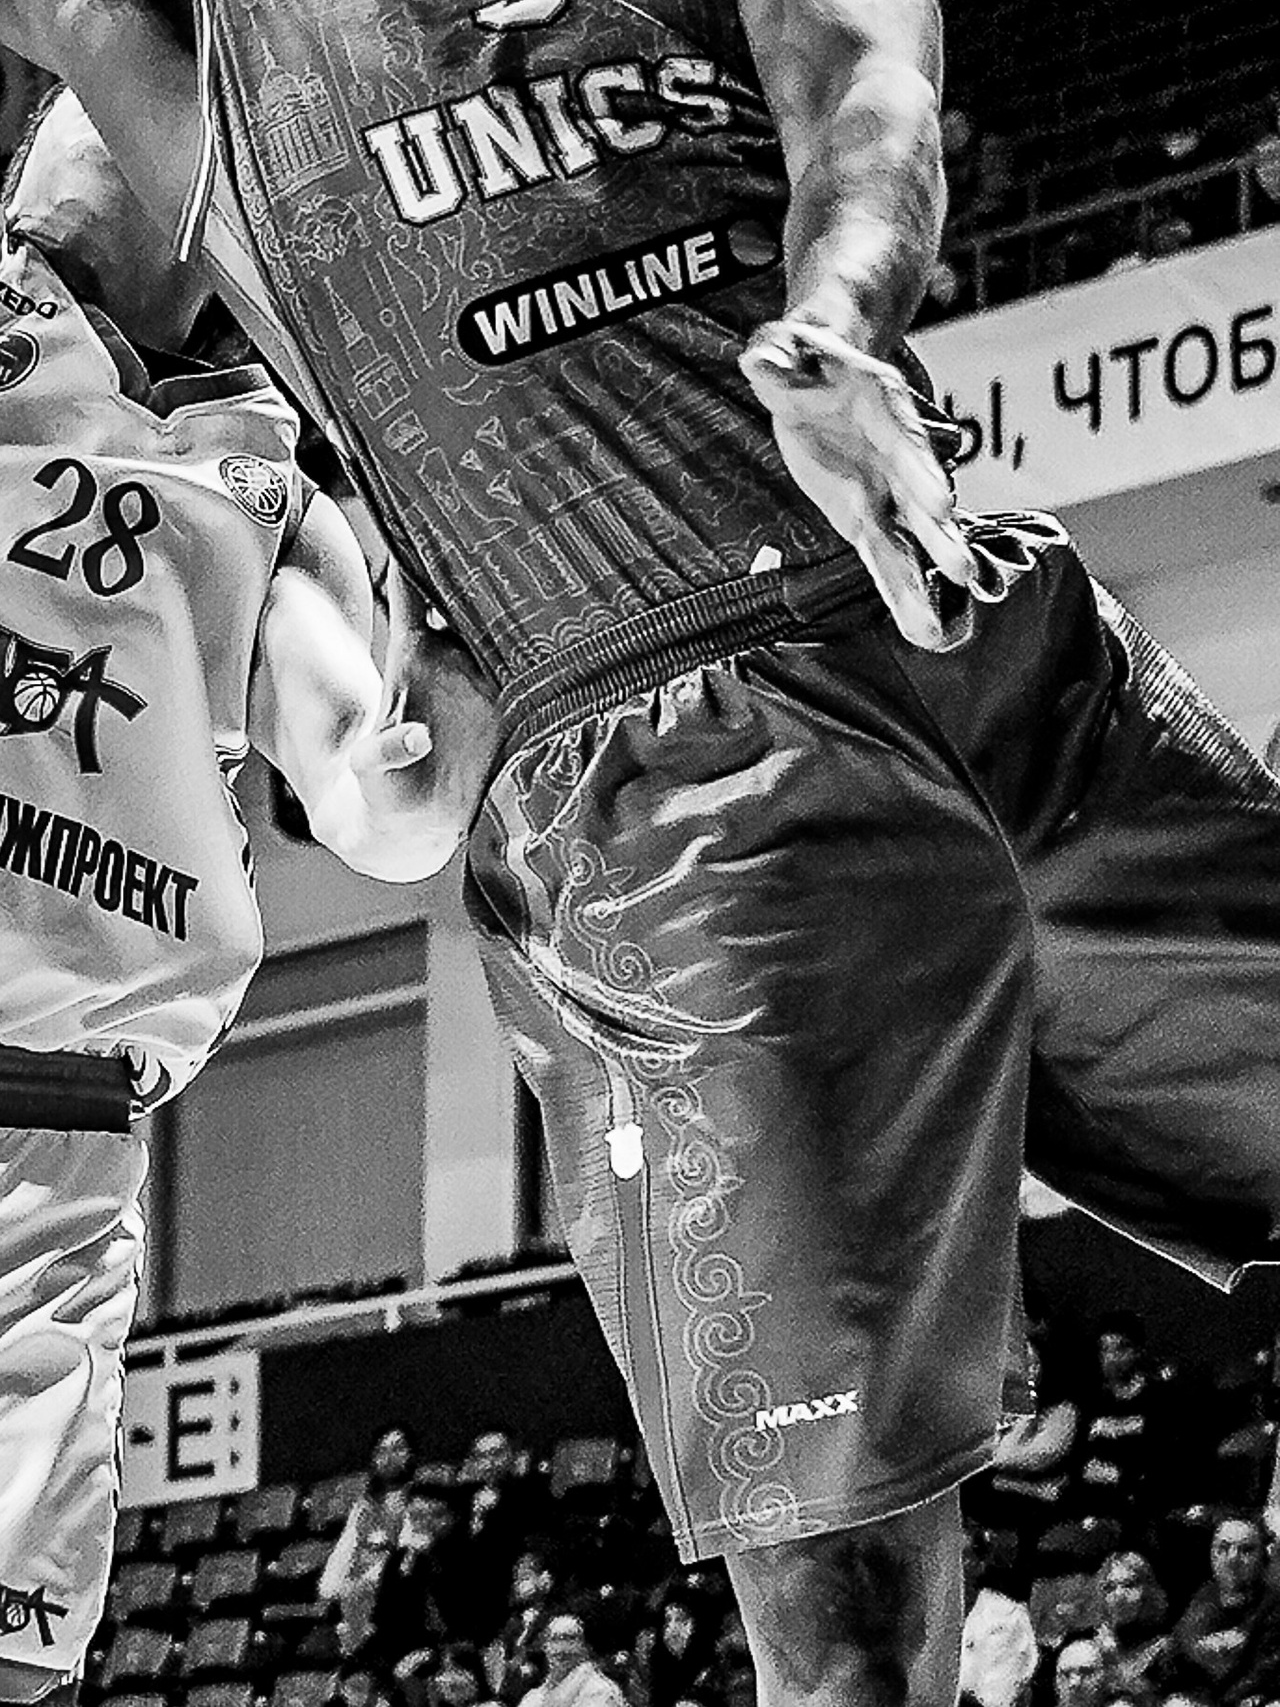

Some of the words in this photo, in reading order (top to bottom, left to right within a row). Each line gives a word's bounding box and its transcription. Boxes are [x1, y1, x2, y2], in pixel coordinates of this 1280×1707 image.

[361, 54, 732, 226] UNICS
[474, 230, 720, 355] WINLINE
[1053, 304, 1276, 435] ЧТОБ
[8, 457, 162, 597] 28
[755, 1390, 859, 1432] MAXX
